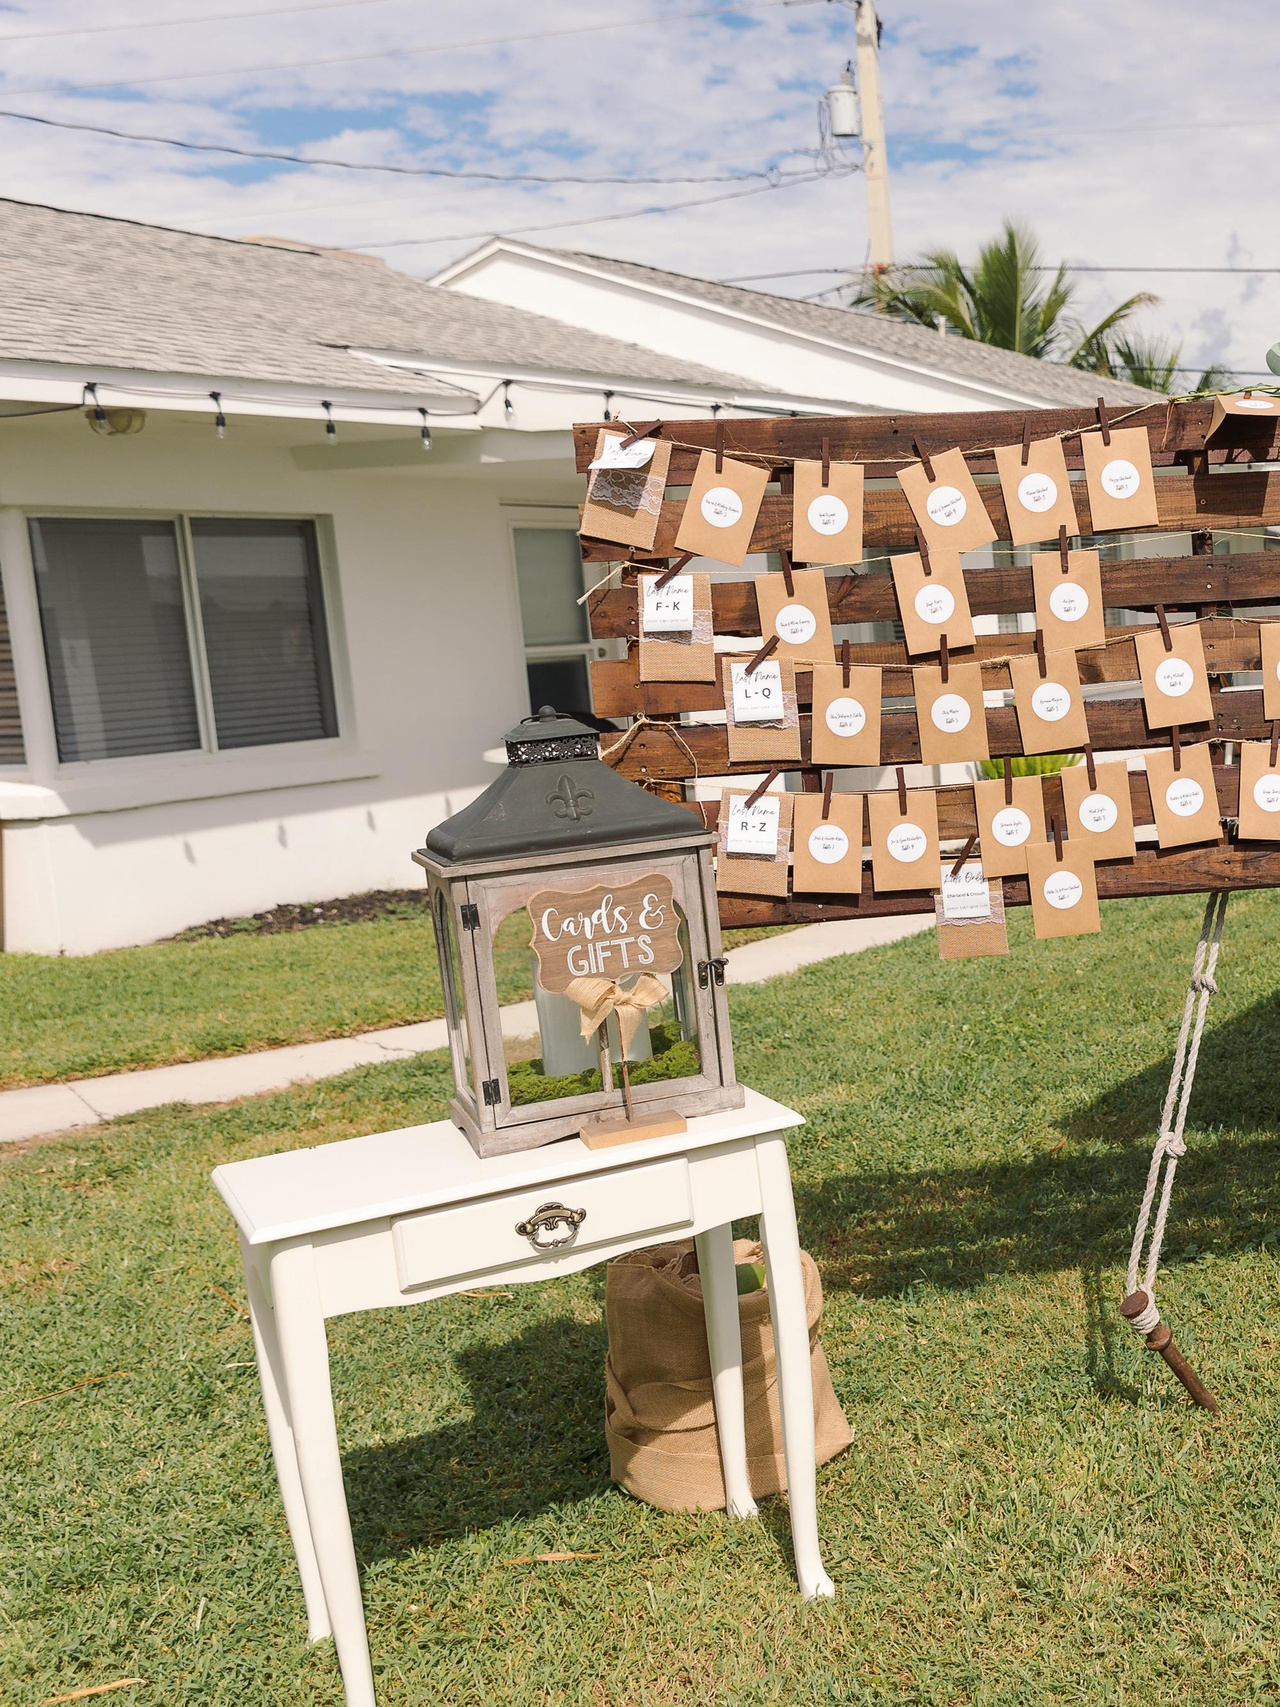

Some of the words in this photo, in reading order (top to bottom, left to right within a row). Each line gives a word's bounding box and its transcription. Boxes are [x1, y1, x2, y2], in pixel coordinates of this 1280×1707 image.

[647, 586, 663, 598] Last
[666, 586, 690, 596] Name
[656, 602, 662, 611] F
[673, 602, 680, 610] K
[735, 673, 751, 685] Last
[754, 671, 778, 682] Name
[745, 689, 751, 698] L
[762, 688, 771, 699] Q
[732, 804, 749, 817] Last
[751, 805, 776, 815] Name
[741, 822, 748, 830] R
[759, 823, 766, 831] Z
[541, 894, 633, 942] Cards
[638, 893, 667, 930] &
[566, 934, 655, 976] GIFTS
